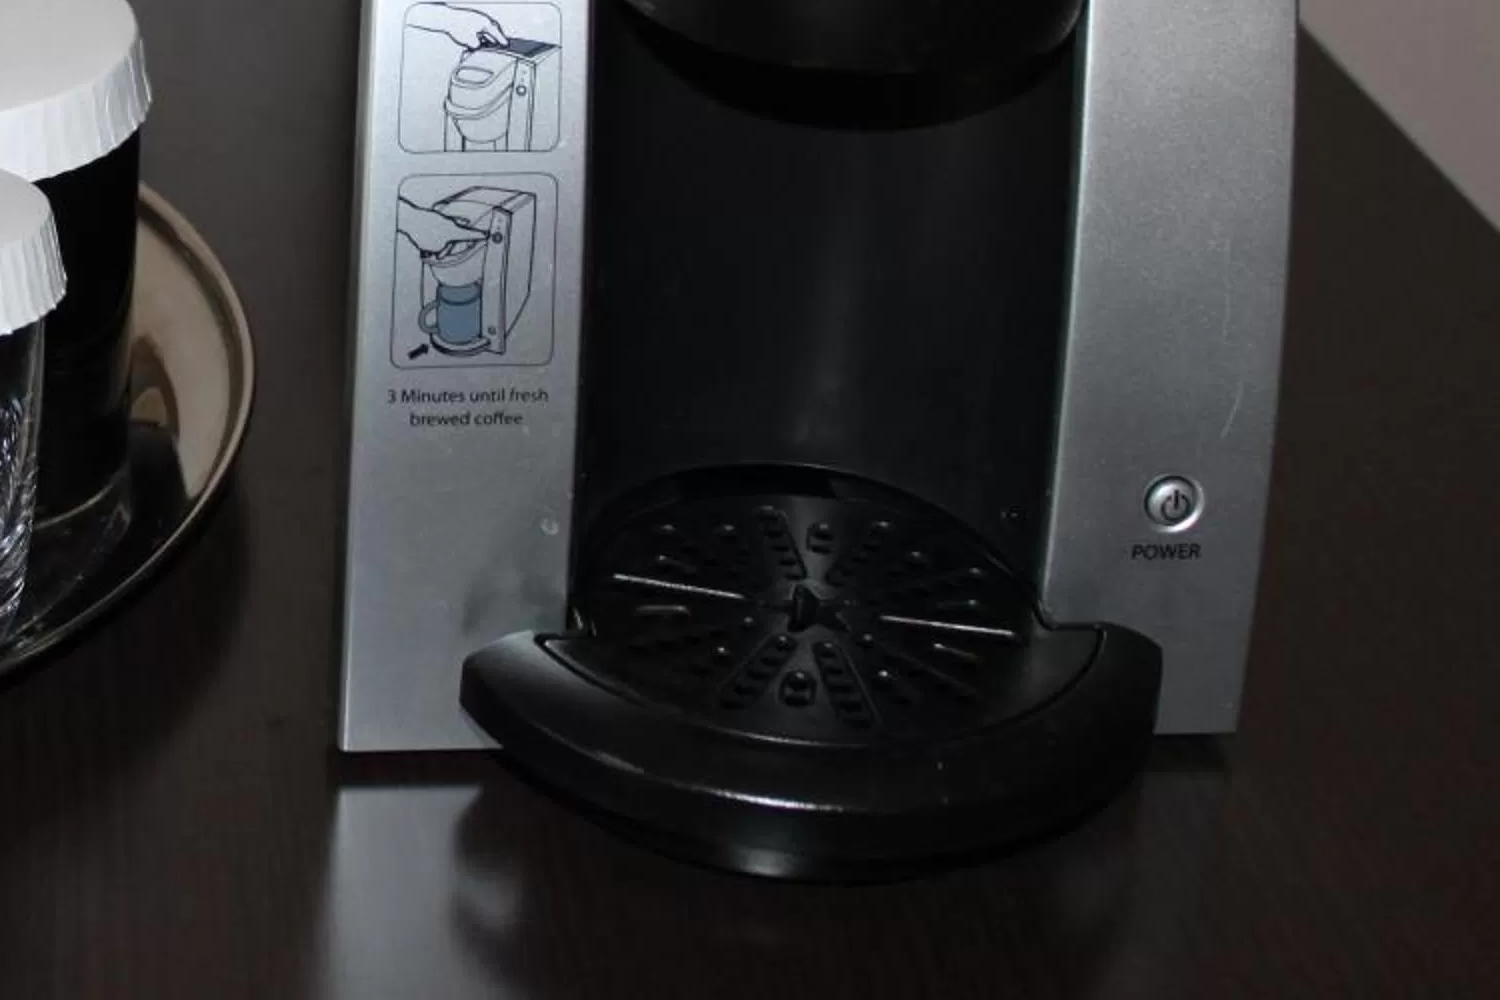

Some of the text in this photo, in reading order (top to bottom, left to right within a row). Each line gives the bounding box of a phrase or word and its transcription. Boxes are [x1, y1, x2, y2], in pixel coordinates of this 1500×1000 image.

[387, 387, 549, 405] 3 Minutes until fresh
[409, 411, 523, 427] brewed coffee
[1131, 543, 1202, 560] POWER
